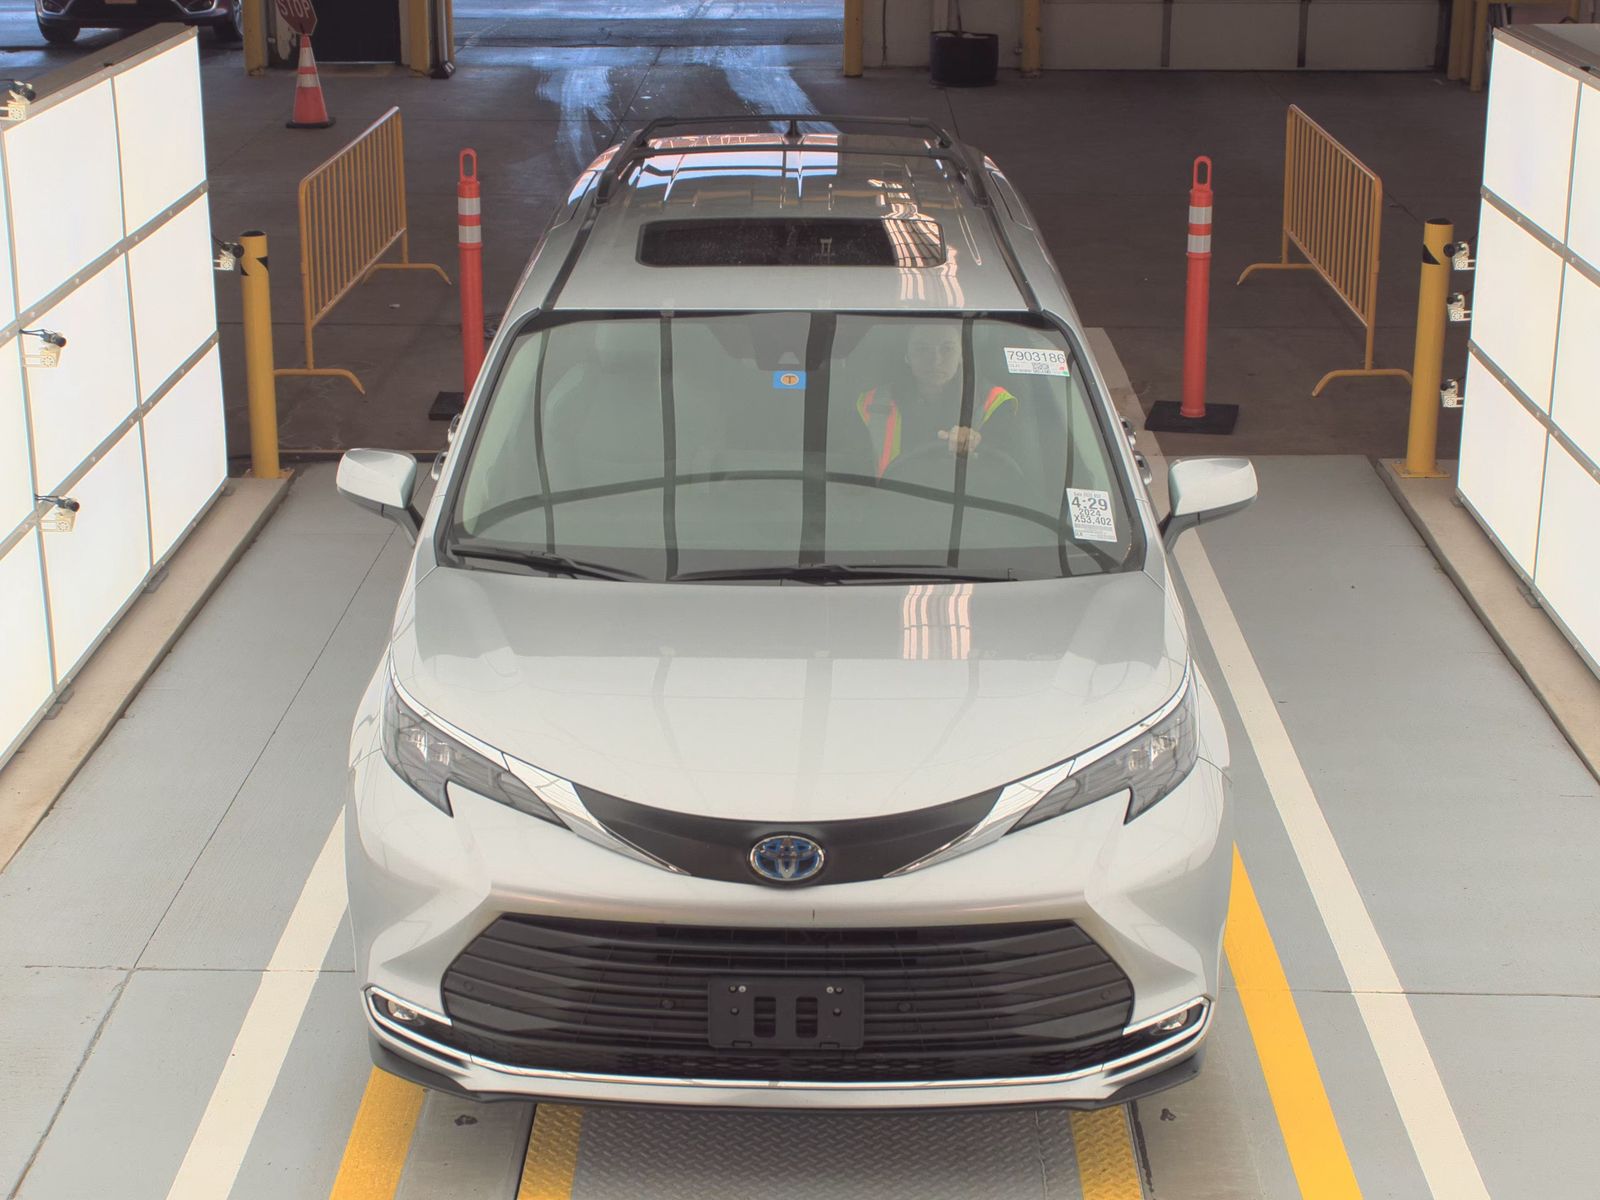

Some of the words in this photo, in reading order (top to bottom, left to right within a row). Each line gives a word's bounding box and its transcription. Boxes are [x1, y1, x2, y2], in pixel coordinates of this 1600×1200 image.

[278, 0, 310, 18] STOP
[1007, 351, 1066, 363] 7903186
[1078, 508, 1102, 517] 2024
